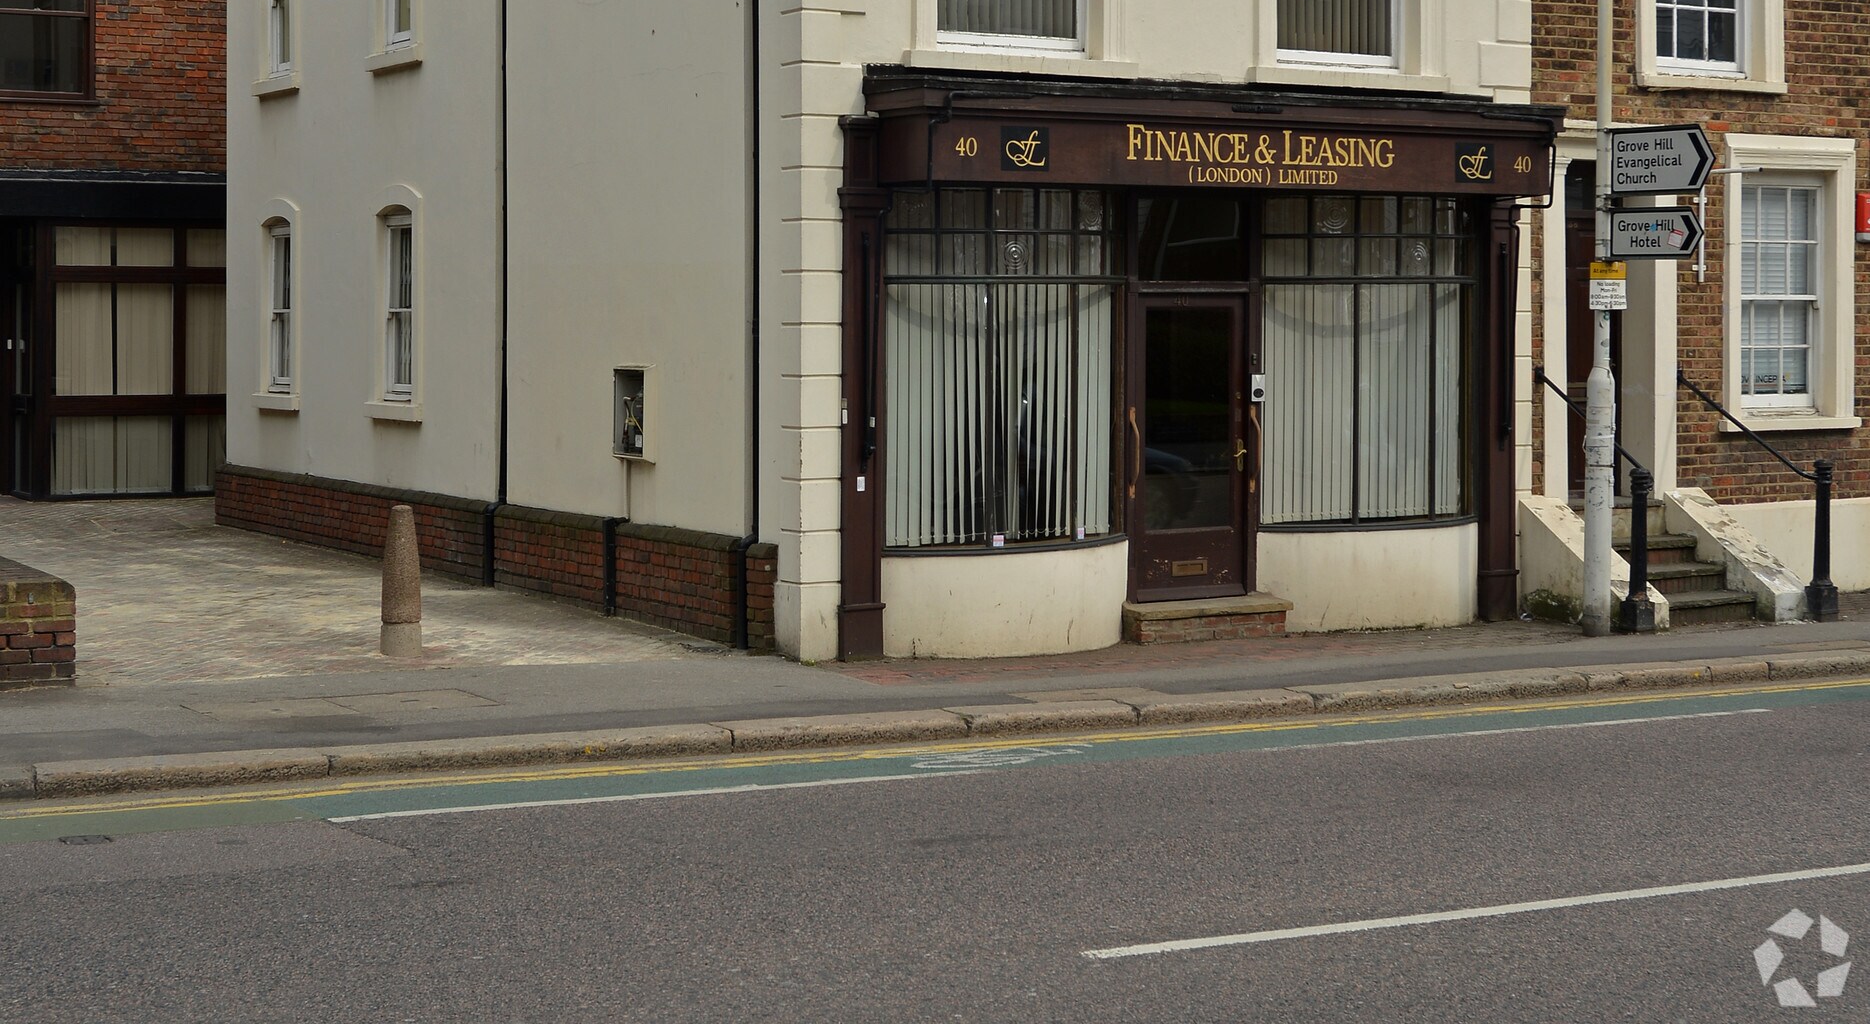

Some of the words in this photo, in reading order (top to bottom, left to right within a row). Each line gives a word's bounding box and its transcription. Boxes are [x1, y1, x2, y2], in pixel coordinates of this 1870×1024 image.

[955, 136, 978, 157] 40
[1126, 123, 1249, 164] FINANCE
[1254, 134, 1277, 165] &
[1282, 130, 1396, 169] LEASING
[1617, 140, 1650, 153] Grove
[1654, 137, 1675, 151] Hill
[1513, 155, 1532, 173] 40
[1616, 154, 1682, 170] Evangelical
[1278, 168, 1338, 186] LIMITED
[1616, 171, 1657, 185] Church
[1618, 219, 1651, 232] Grove
[1655, 218, 1675, 232] Hill
[1630, 235, 1662, 248] Hotel
